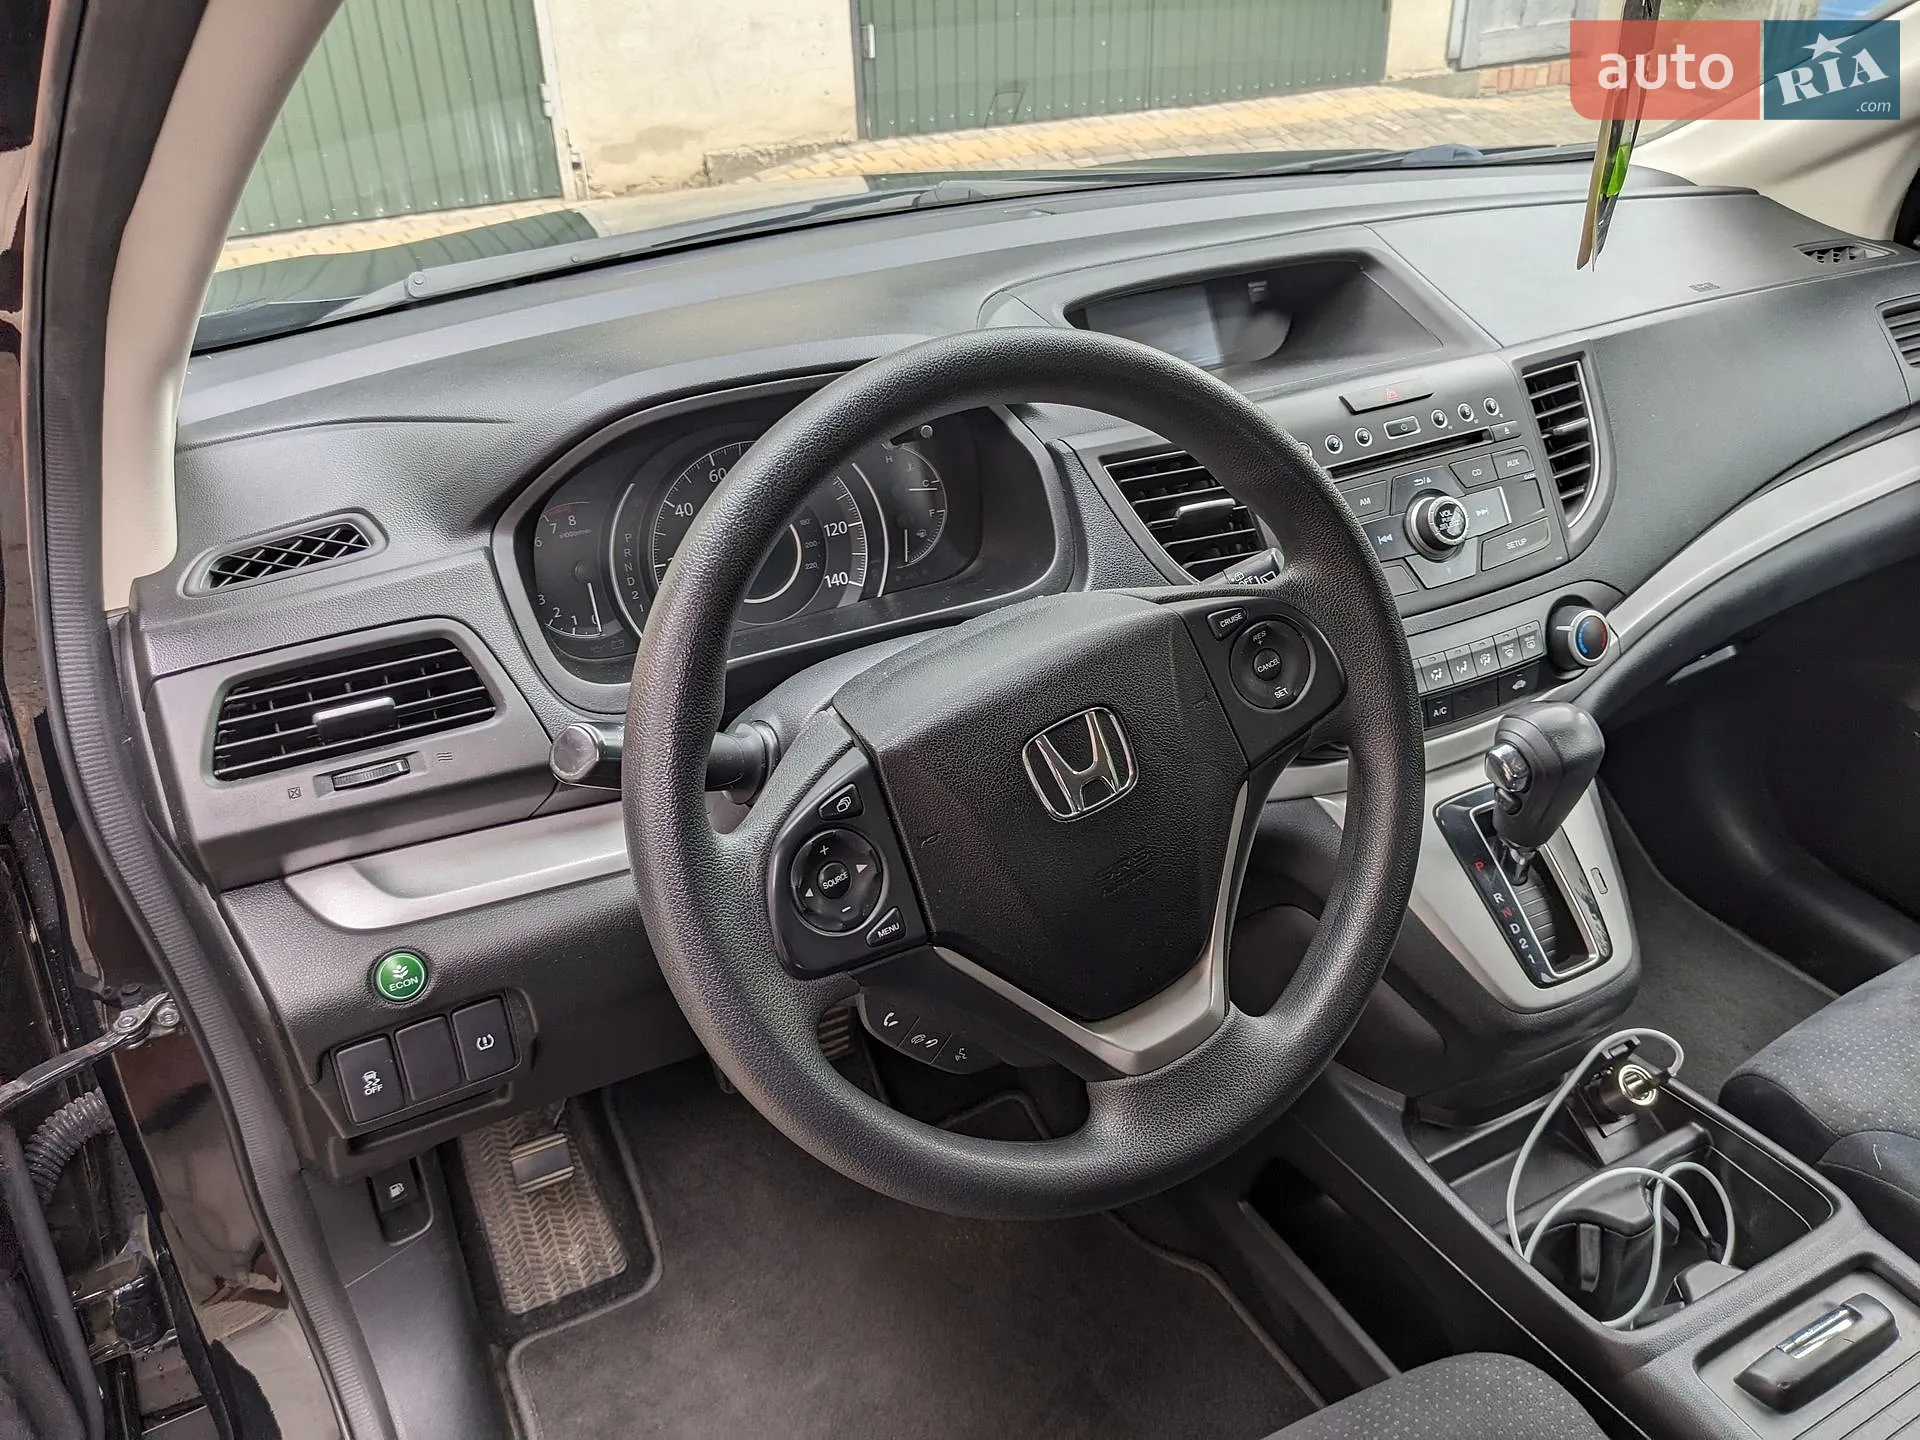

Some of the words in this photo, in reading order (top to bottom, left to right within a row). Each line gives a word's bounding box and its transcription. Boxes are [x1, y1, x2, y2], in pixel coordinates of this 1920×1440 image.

[709, 467, 728, 483] 60
[674, 502, 694, 517] 40
[549, 522, 557, 534] 7
[567, 515, 577, 526] 8
[823, 521, 848, 537] 120
[824, 571, 849, 588] 140
[537, 594, 546, 606] 3
[552, 607, 562, 618] 2
[1219, 612, 1243, 628] CRUISE
[571, 615, 578, 626] 1
[1257, 658, 1281, 673] CANCEL
[1274, 688, 1290, 699] SET
[1433, 706, 1448, 718] A/C
[822, 871, 849, 890] SOURCE
[1475, 861, 1485, 872] P
[1492, 892, 1504, 904] R
[1509, 923, 1521, 935] D
[1518, 937, 1529, 950] 2
[1527, 954, 1536, 964] 1
[877, 923, 900, 938] MENU
[388, 976, 419, 992] ECON
[364, 1084, 383, 1096] OFF
